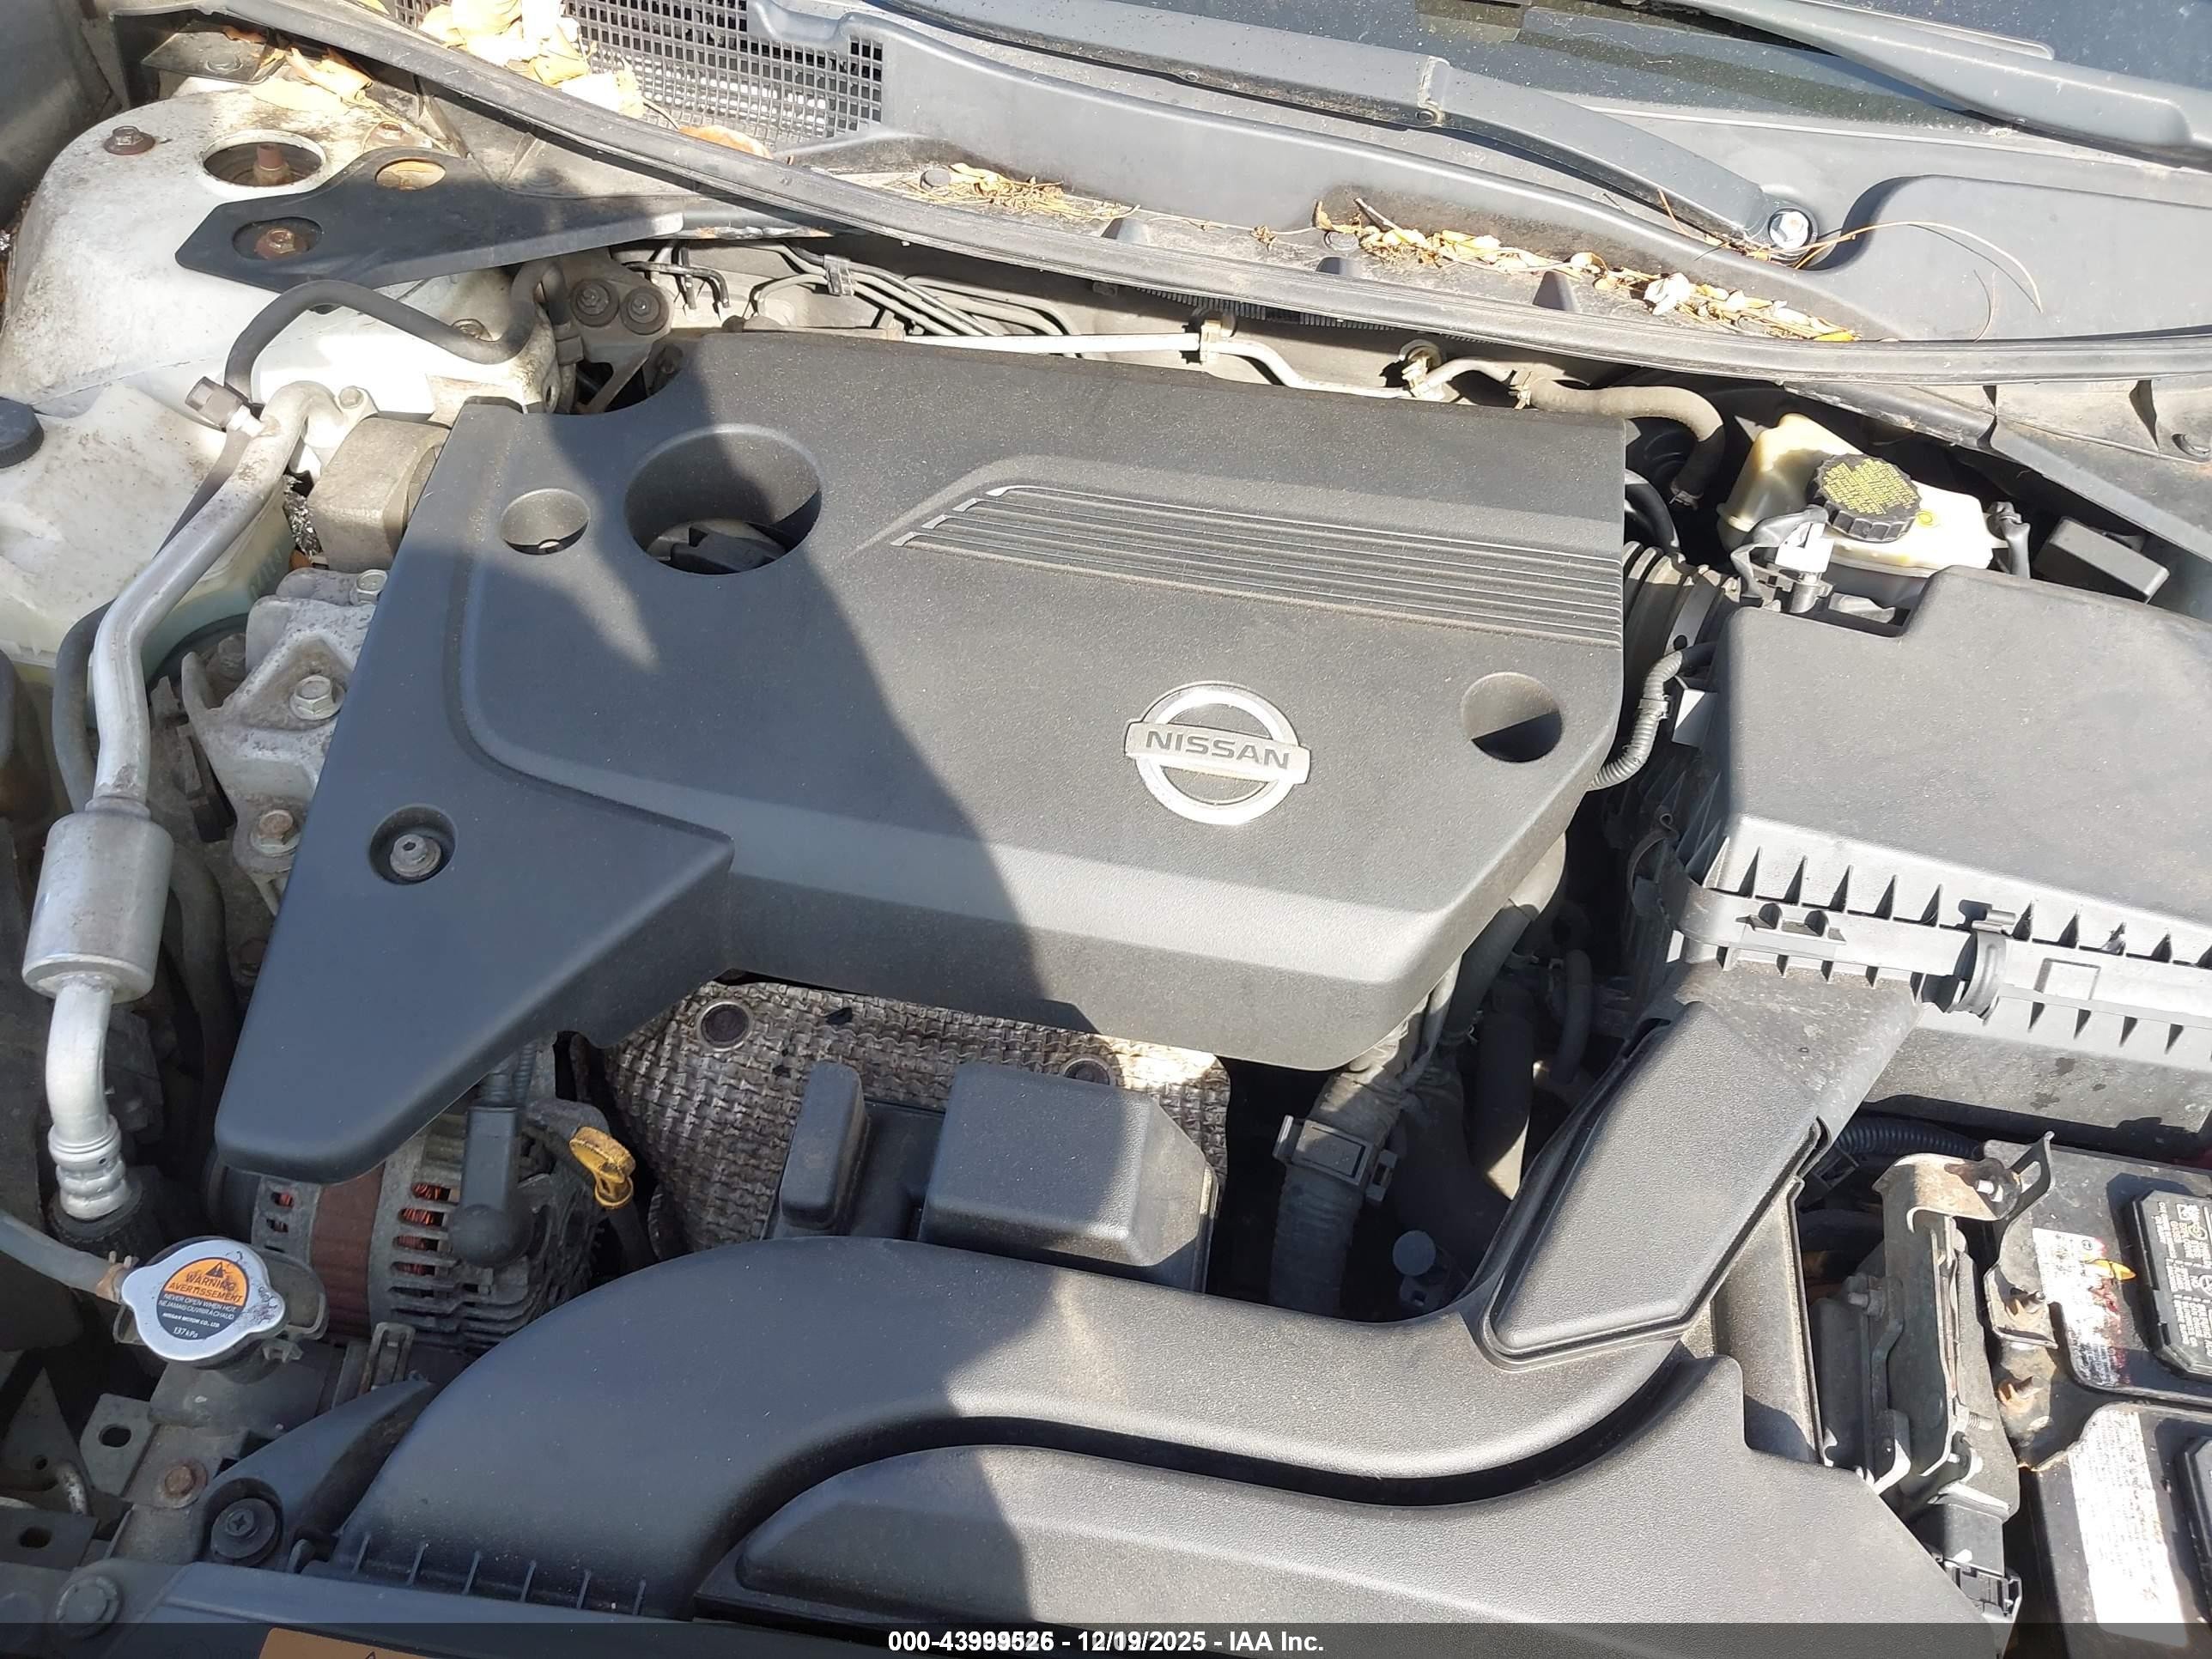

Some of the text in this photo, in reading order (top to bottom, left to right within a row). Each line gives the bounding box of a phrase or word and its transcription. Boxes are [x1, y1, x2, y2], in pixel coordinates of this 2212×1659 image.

[1146, 730, 1291, 770] NISSAN
[185, 1272, 235, 1291] WARNING
[168, 1282, 243, 1304] AVERTISSEMENT
[185, 1297, 203, 1306] OPEN
[203, 1300, 223, 1310] WHEN
